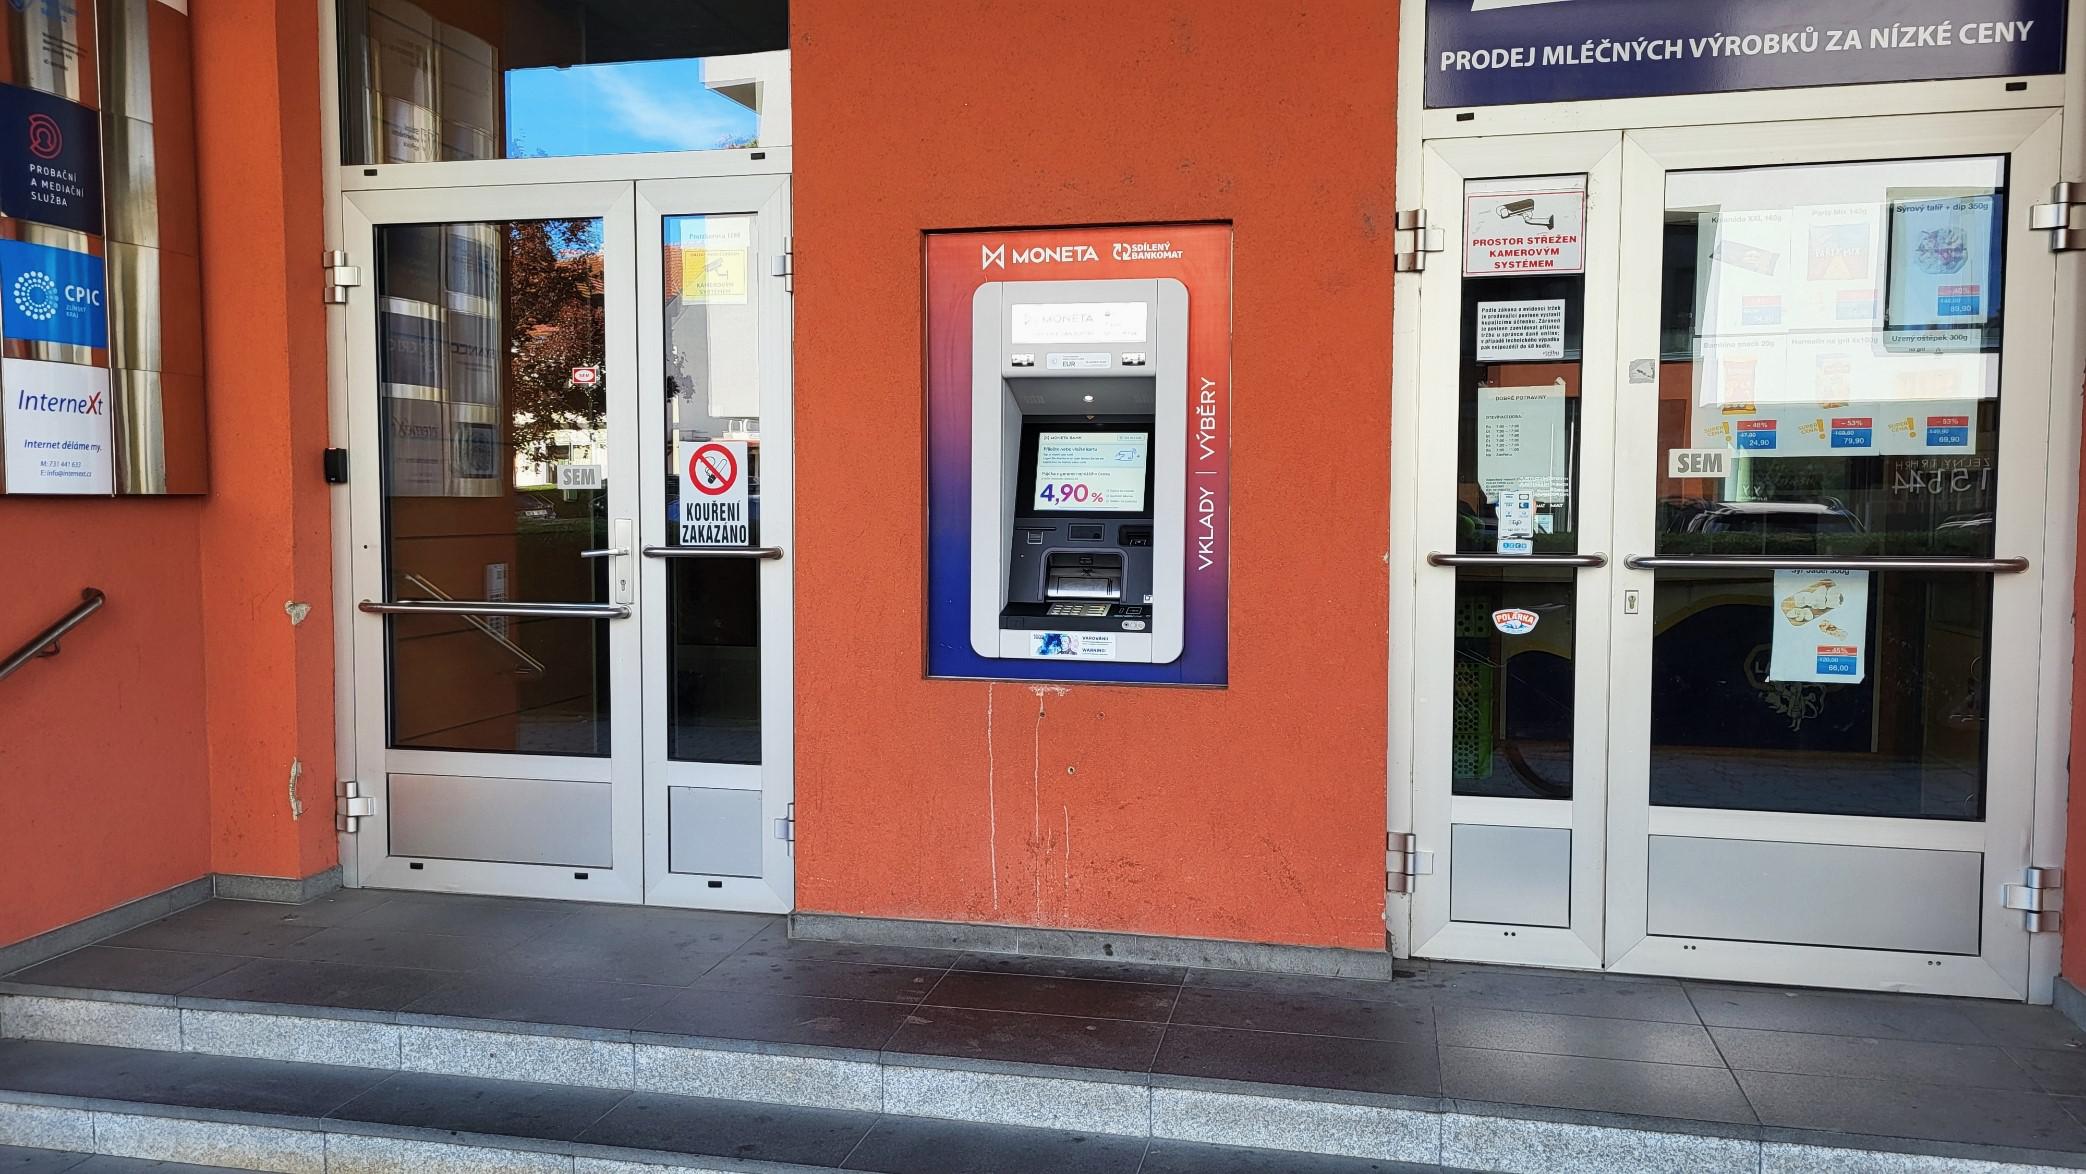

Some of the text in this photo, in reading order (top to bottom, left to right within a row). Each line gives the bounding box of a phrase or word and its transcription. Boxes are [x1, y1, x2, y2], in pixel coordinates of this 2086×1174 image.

[1440, 20, 2034, 71] PRODEJ MLÉČNÝCH VÝROBKŮ ZA NÍZKÉ CENY
[30, 164, 77, 182] PROBAČNÍ
[31, 178, 84, 198] A MEDIAČNÍ
[32, 191, 68, 206] SLUŽBA
[1952, 203, 1966, 211] dip
[1131, 241, 1170, 251] SDÍLENÝ
[1472, 235, 1577, 247] PROSTOR STŘEŽEN
[1012, 246, 1099, 264] MONETA
[1131, 250, 1183, 260] BANKOMAT
[1489, 247, 1560, 258] KAMEROVÝM
[1494, 259, 1554, 269] SYSTÉMEM
[65, 285, 100, 306] CPIC
[18, 389, 104, 416] InterneXt
[1196, 376, 1216, 460] VÝBĚRY
[24, 439, 60, 450] Internet
[62, 440, 90, 450] děláme
[1678, 453, 1722, 473] SEM
[563, 468, 595, 486] SEM
[1040, 484, 1088, 506] 4,90
[1091, 492, 1104, 503] %
[686, 500, 740, 521] KOUŘENÍ
[682, 521, 746, 544] ZAKÁZÁNO
[1198, 486, 1214, 570] VKLADY
